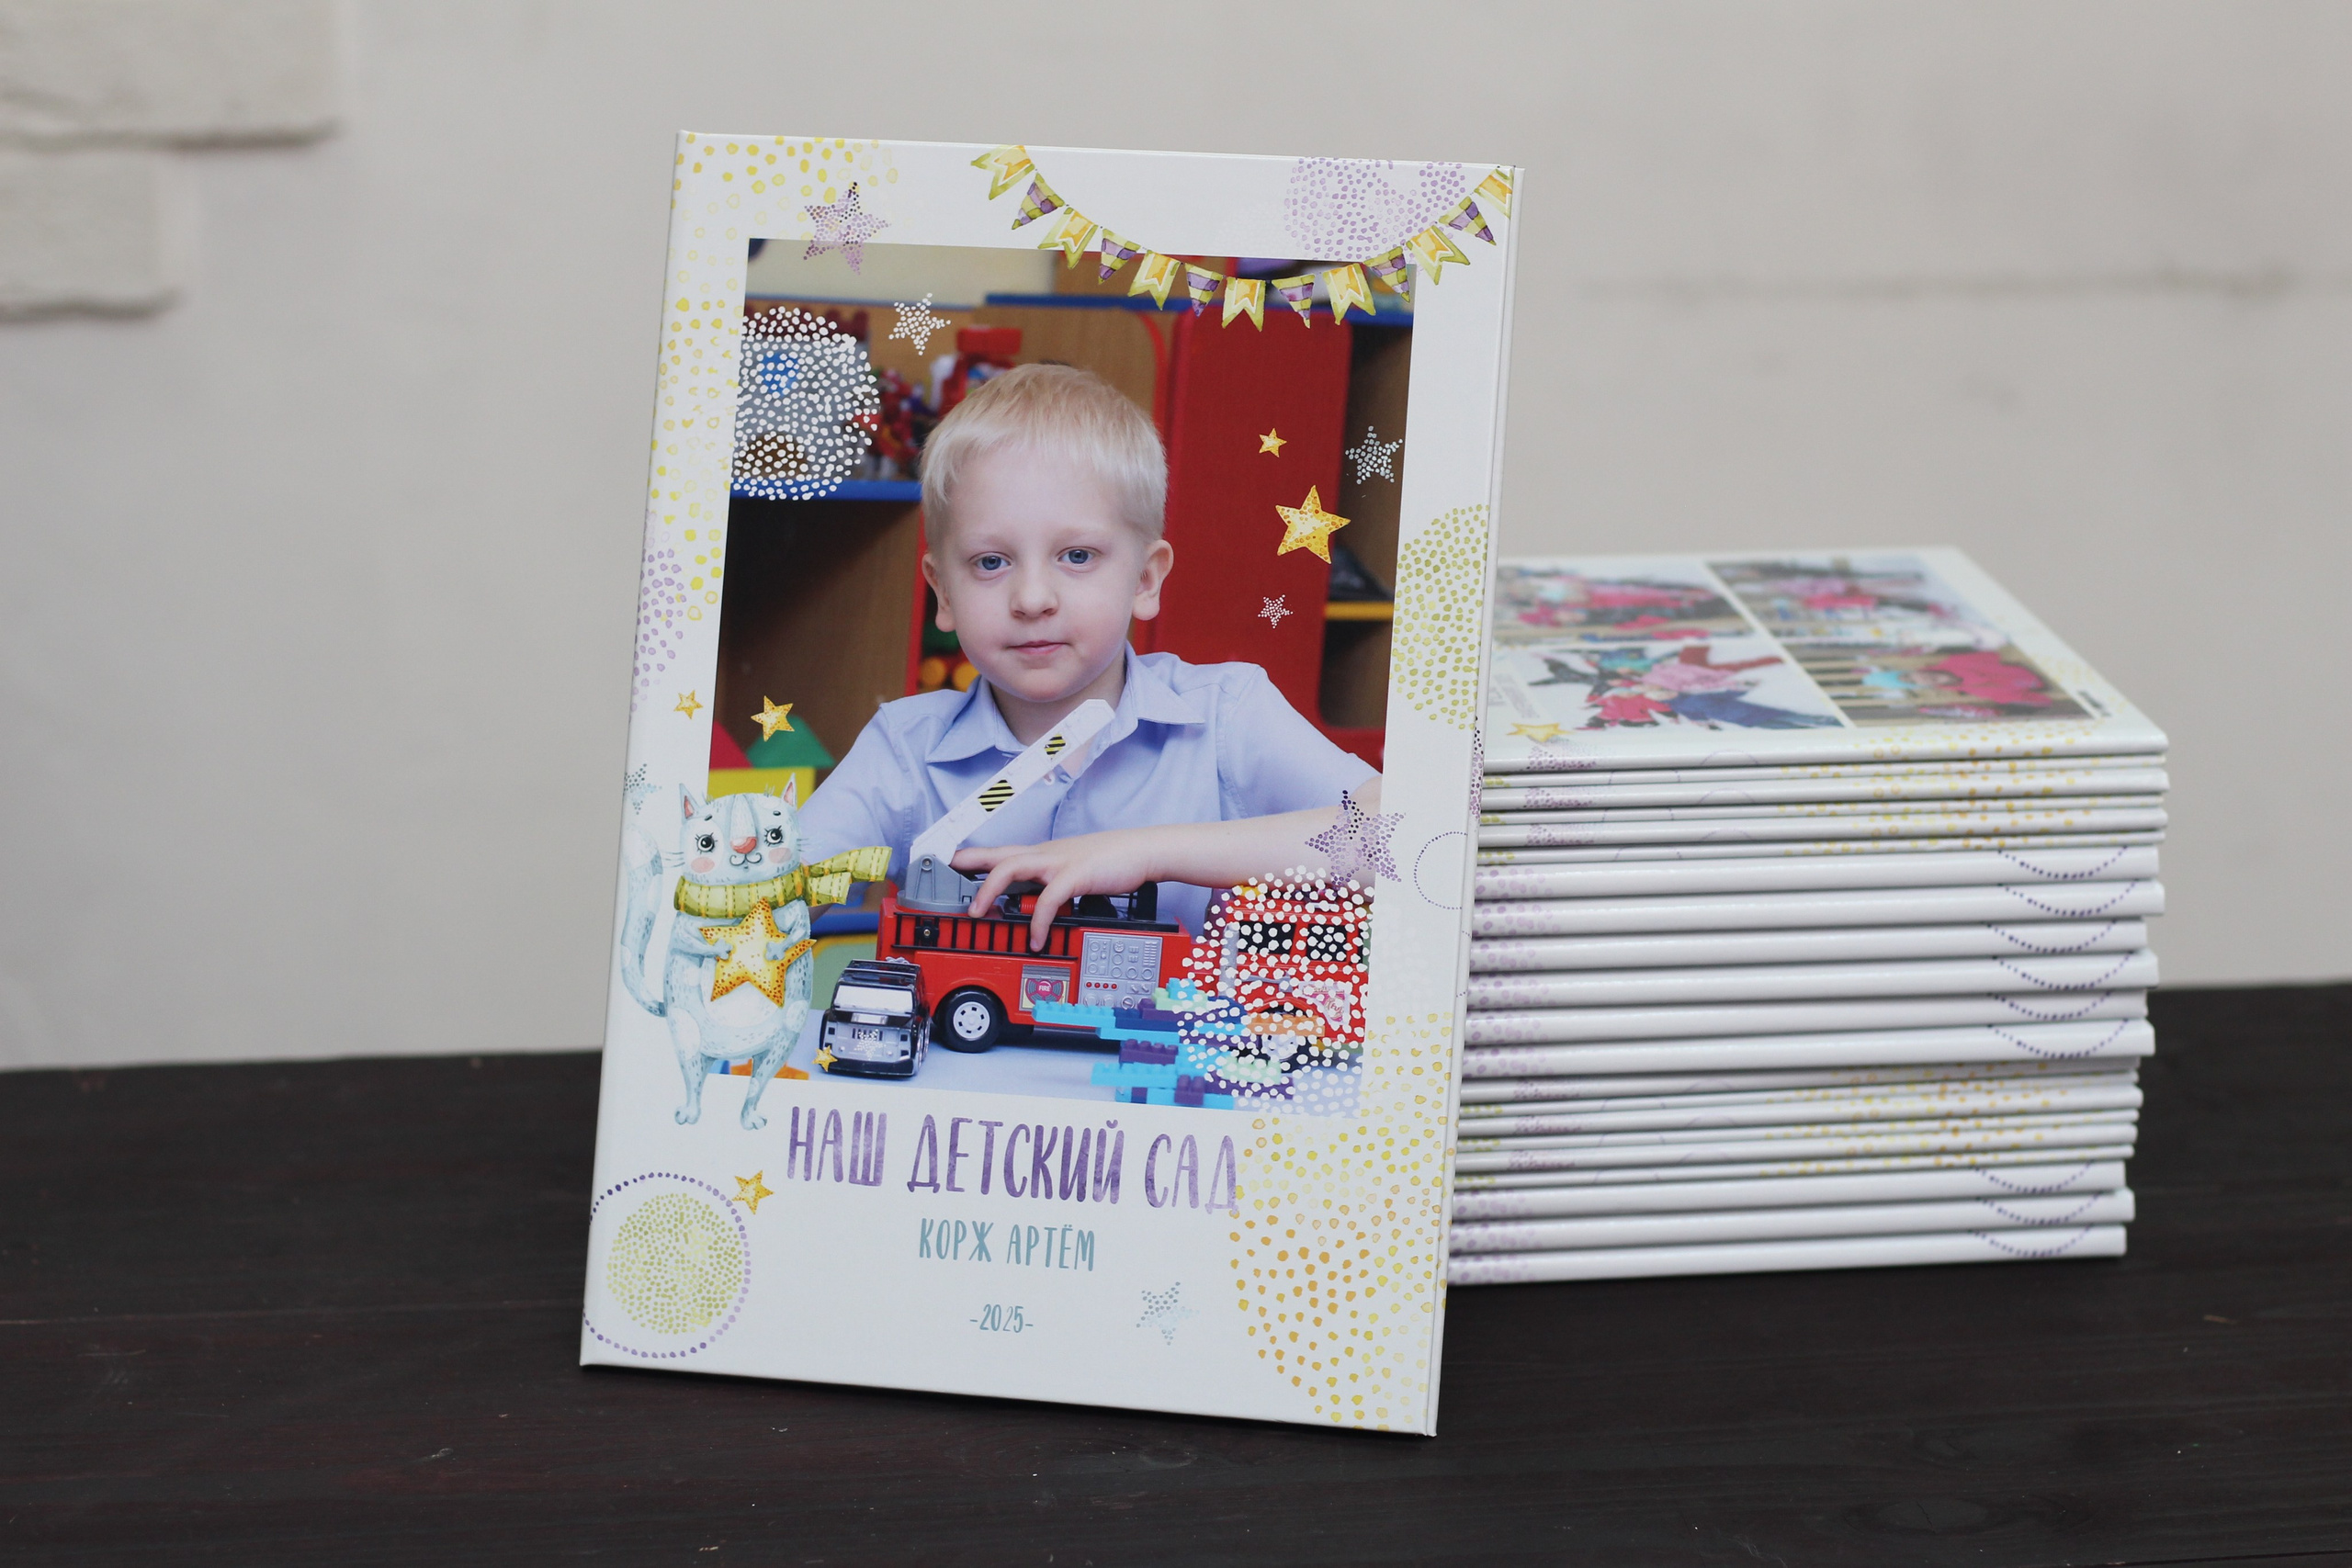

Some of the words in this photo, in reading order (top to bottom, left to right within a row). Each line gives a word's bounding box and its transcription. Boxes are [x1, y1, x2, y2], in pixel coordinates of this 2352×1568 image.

[787, 1106, 887, 1187] НАШ
[907, 1113, 1125, 1204] ДЕТСКИЙ
[1145, 1134, 1238, 1215] САД
[920, 1218, 994, 1262] КОРЖ
[1007, 1224, 1095, 1271] АРТЁМ
